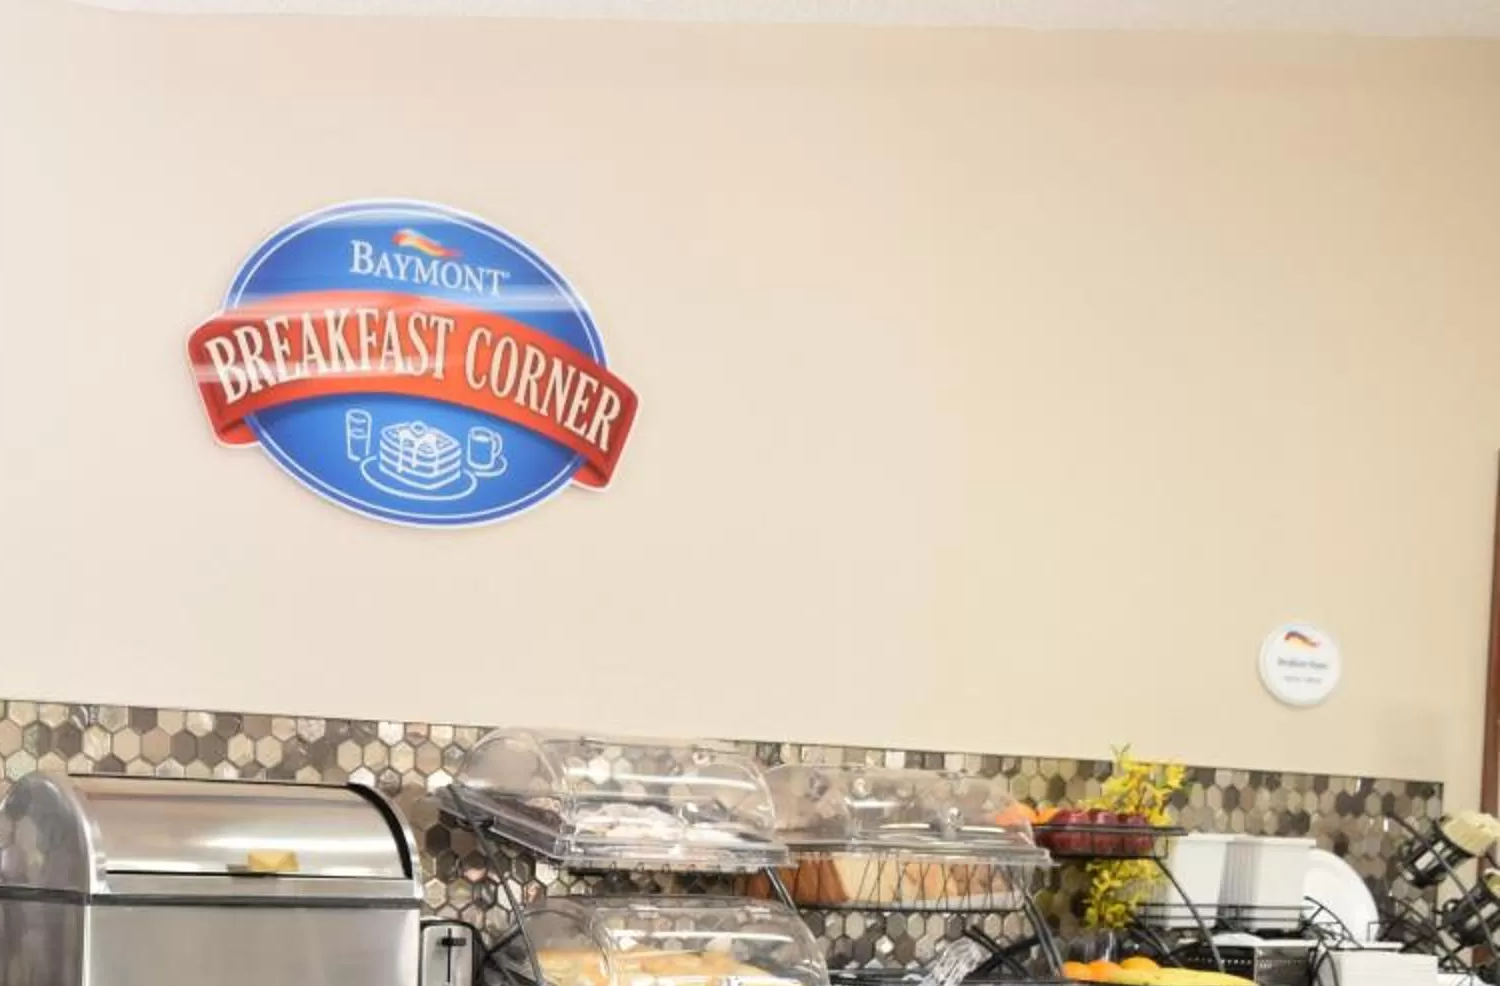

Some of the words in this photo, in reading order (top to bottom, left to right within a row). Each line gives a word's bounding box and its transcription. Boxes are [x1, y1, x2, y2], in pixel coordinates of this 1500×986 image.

[350, 239, 503, 297] BAYMONT
[205, 307, 455, 404] BREAKFAST
[465, 327, 623, 452] CORNER
